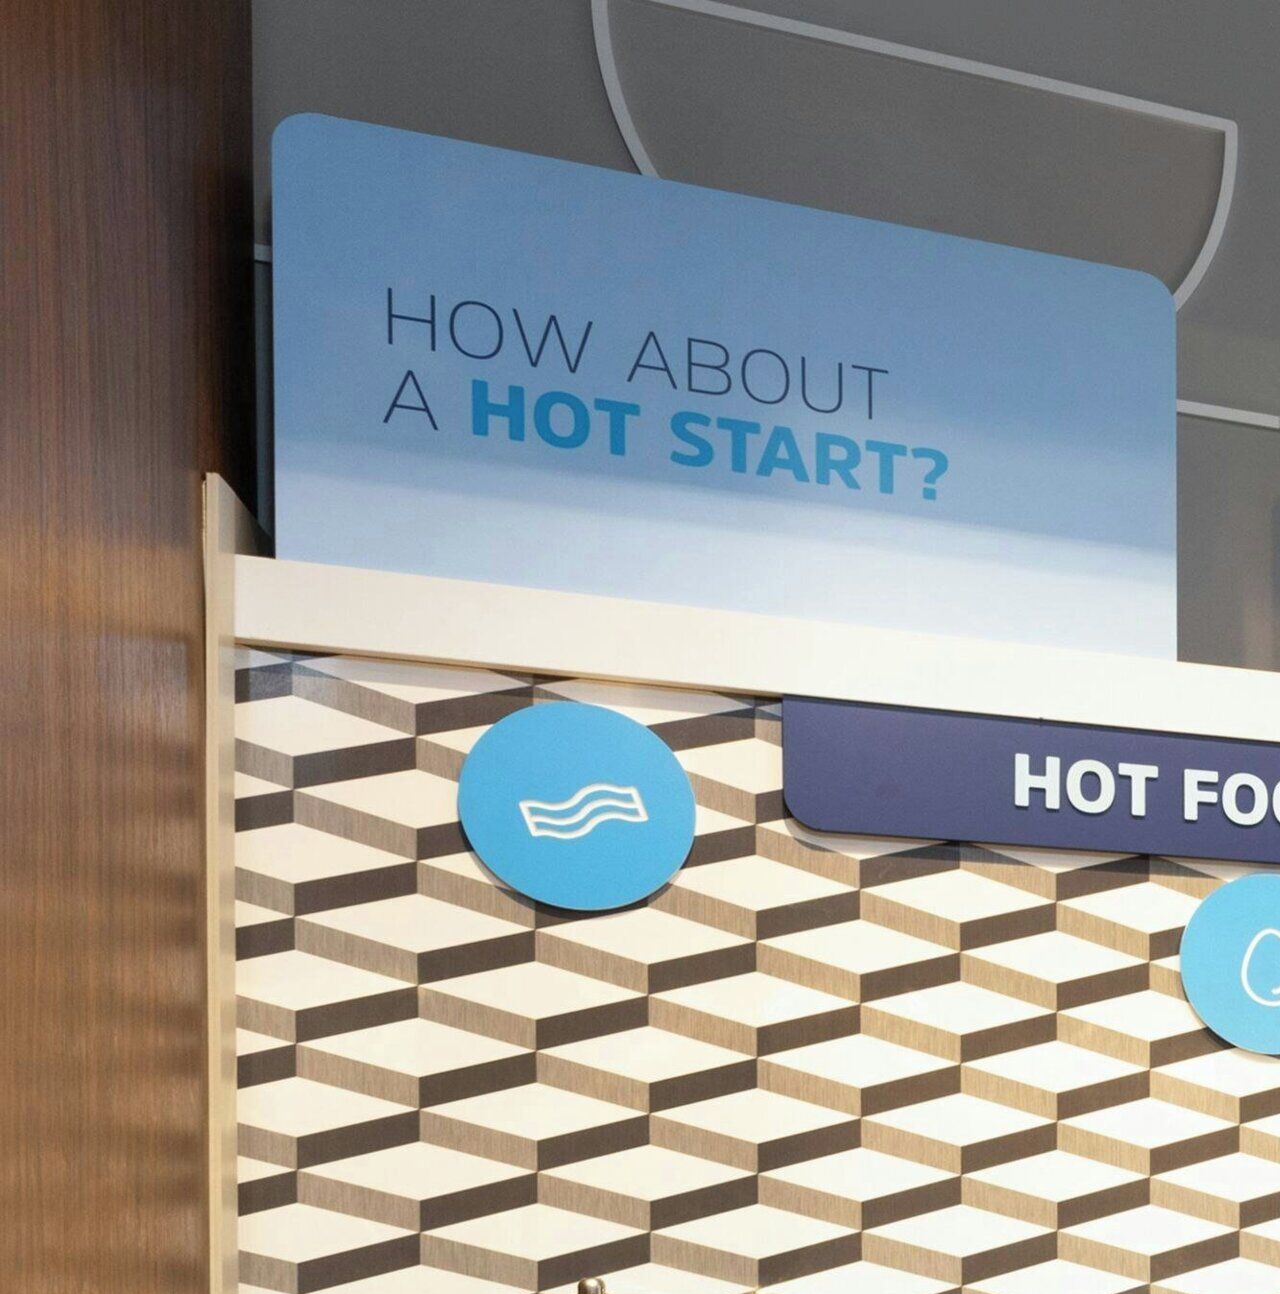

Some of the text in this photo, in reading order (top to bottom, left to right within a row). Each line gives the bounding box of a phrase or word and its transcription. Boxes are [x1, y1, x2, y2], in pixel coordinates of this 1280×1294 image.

[386, 288, 889, 420] HOW ABOUT
[383, 370, 949, 501] A HOT START?
[1014, 753, 1159, 817] HOT
